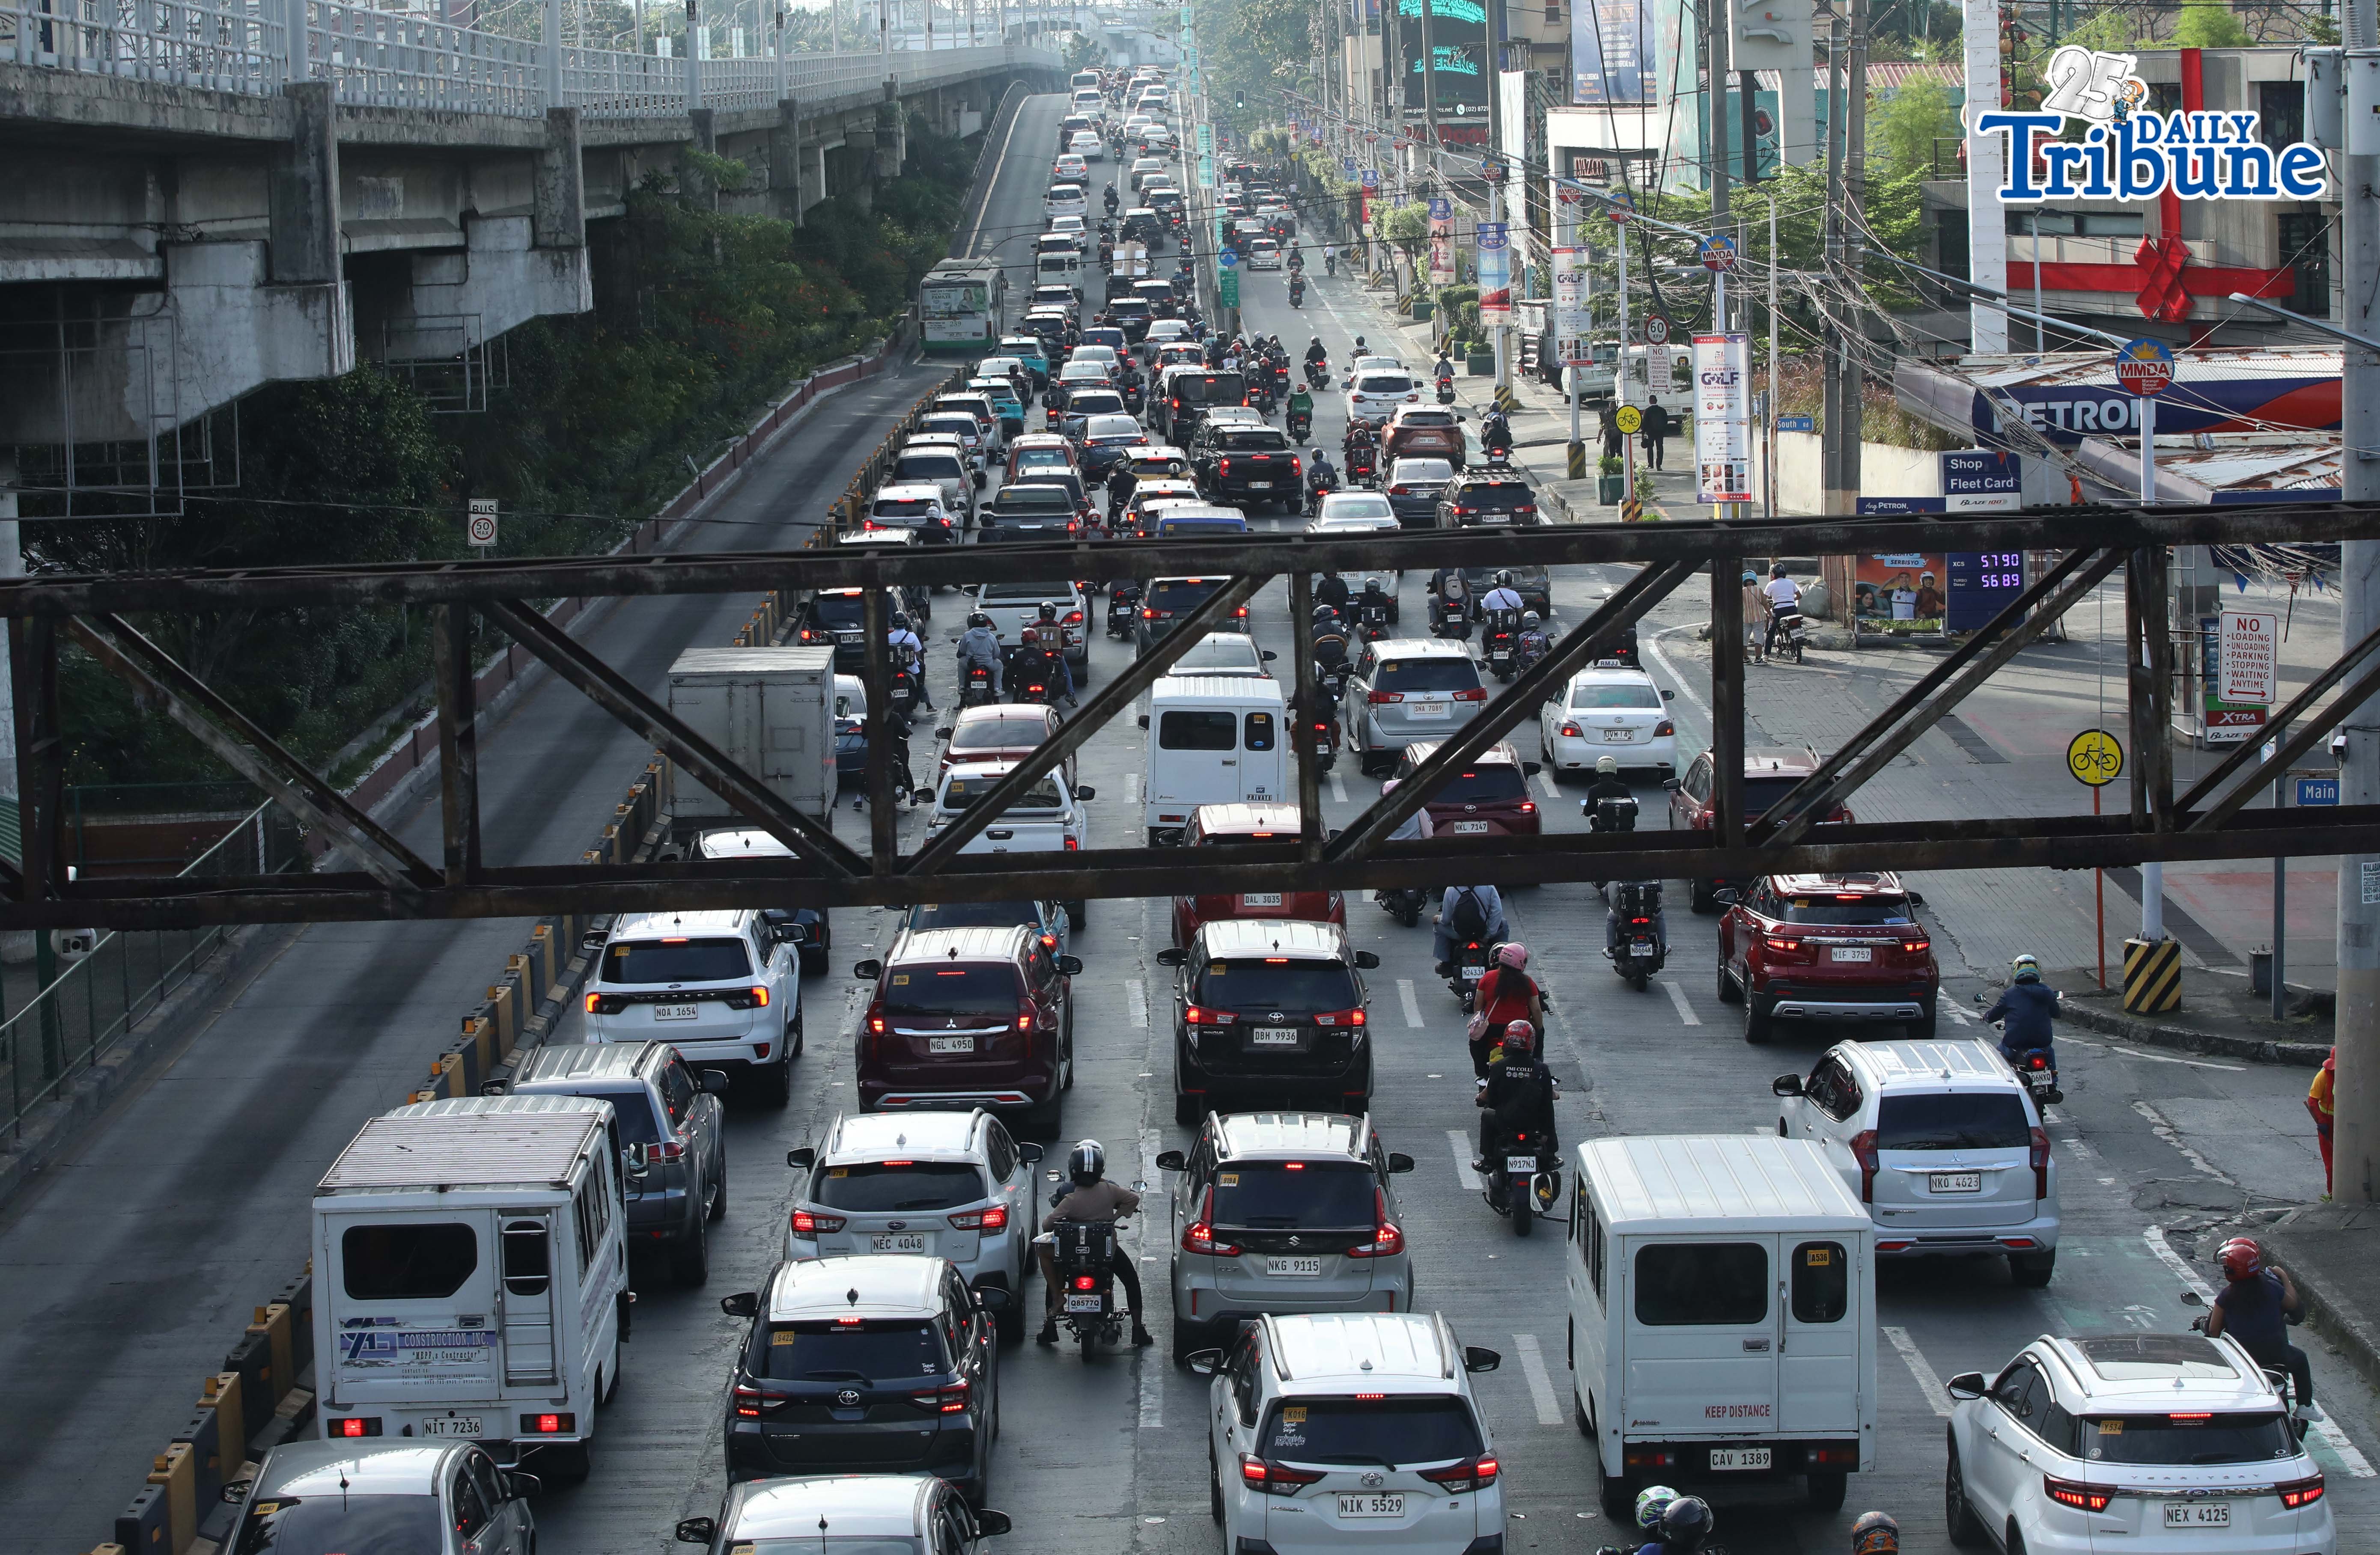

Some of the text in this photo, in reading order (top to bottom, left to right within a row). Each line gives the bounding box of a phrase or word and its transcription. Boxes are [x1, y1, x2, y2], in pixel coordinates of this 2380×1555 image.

[1624, 6, 1634, 18] TEST
[1702, 250, 1733, 260] MMDA
[1650, 322, 1664, 333] 60
[2121, 363, 2170, 377] MMDA
[1778, 420, 1797, 428] South
[1951, 459, 1982, 470] Shop
[1951, 477, 2014, 489] Fleet Card
[472, 505, 494, 514] BUS
[1865, 502, 1878, 511] Ang
[477, 522, 489, 530] 50
[2237, 618, 2260, 632] NO
[2231, 633, 2270, 642] LOADING
[2231, 642, 2270, 651] UNLOADING
[2231, 651, 2269, 661] PARKING
[2231, 660, 2269, 670] STOPPING
[2231, 670, 2269, 680] WAITING
[2231, 679, 2264, 689] ANYTIME
[2218, 712, 2256, 724] XTRA
[2306, 784, 2334, 798] Main
[1263, 895, 1280, 903] 3035
[1833, 950, 1870, 959] NIF 3757
[656, 1007, 696, 1017] NOA 1654
[1255, 1031, 1296, 1040] DBH 9936
[931, 1039, 972, 1050] NGL 4950
[1509, 1160, 1535, 1168] N917NJ
[1955, 1177, 1978, 1188] 4623
[873, 1238, 922, 1249] NEC 4048
[1811, 1253, 1827, 1262] A536
[1268, 1261, 1319, 1271] NKG 9115
[404, 1332, 489, 1347] CONSTRUCTION, INC.
[1289, 1410, 1305, 1418] K016
[1705, 1404, 1770, 1418] KEEP DISTANCE
[425, 1421, 480, 1434] NIT 7236
[1712, 1453, 1769, 1466] CAV 1389
[1340, 1499, 1402, 1512] NIK 5529
[2167, 1508, 2228, 1522] NEX 4125
